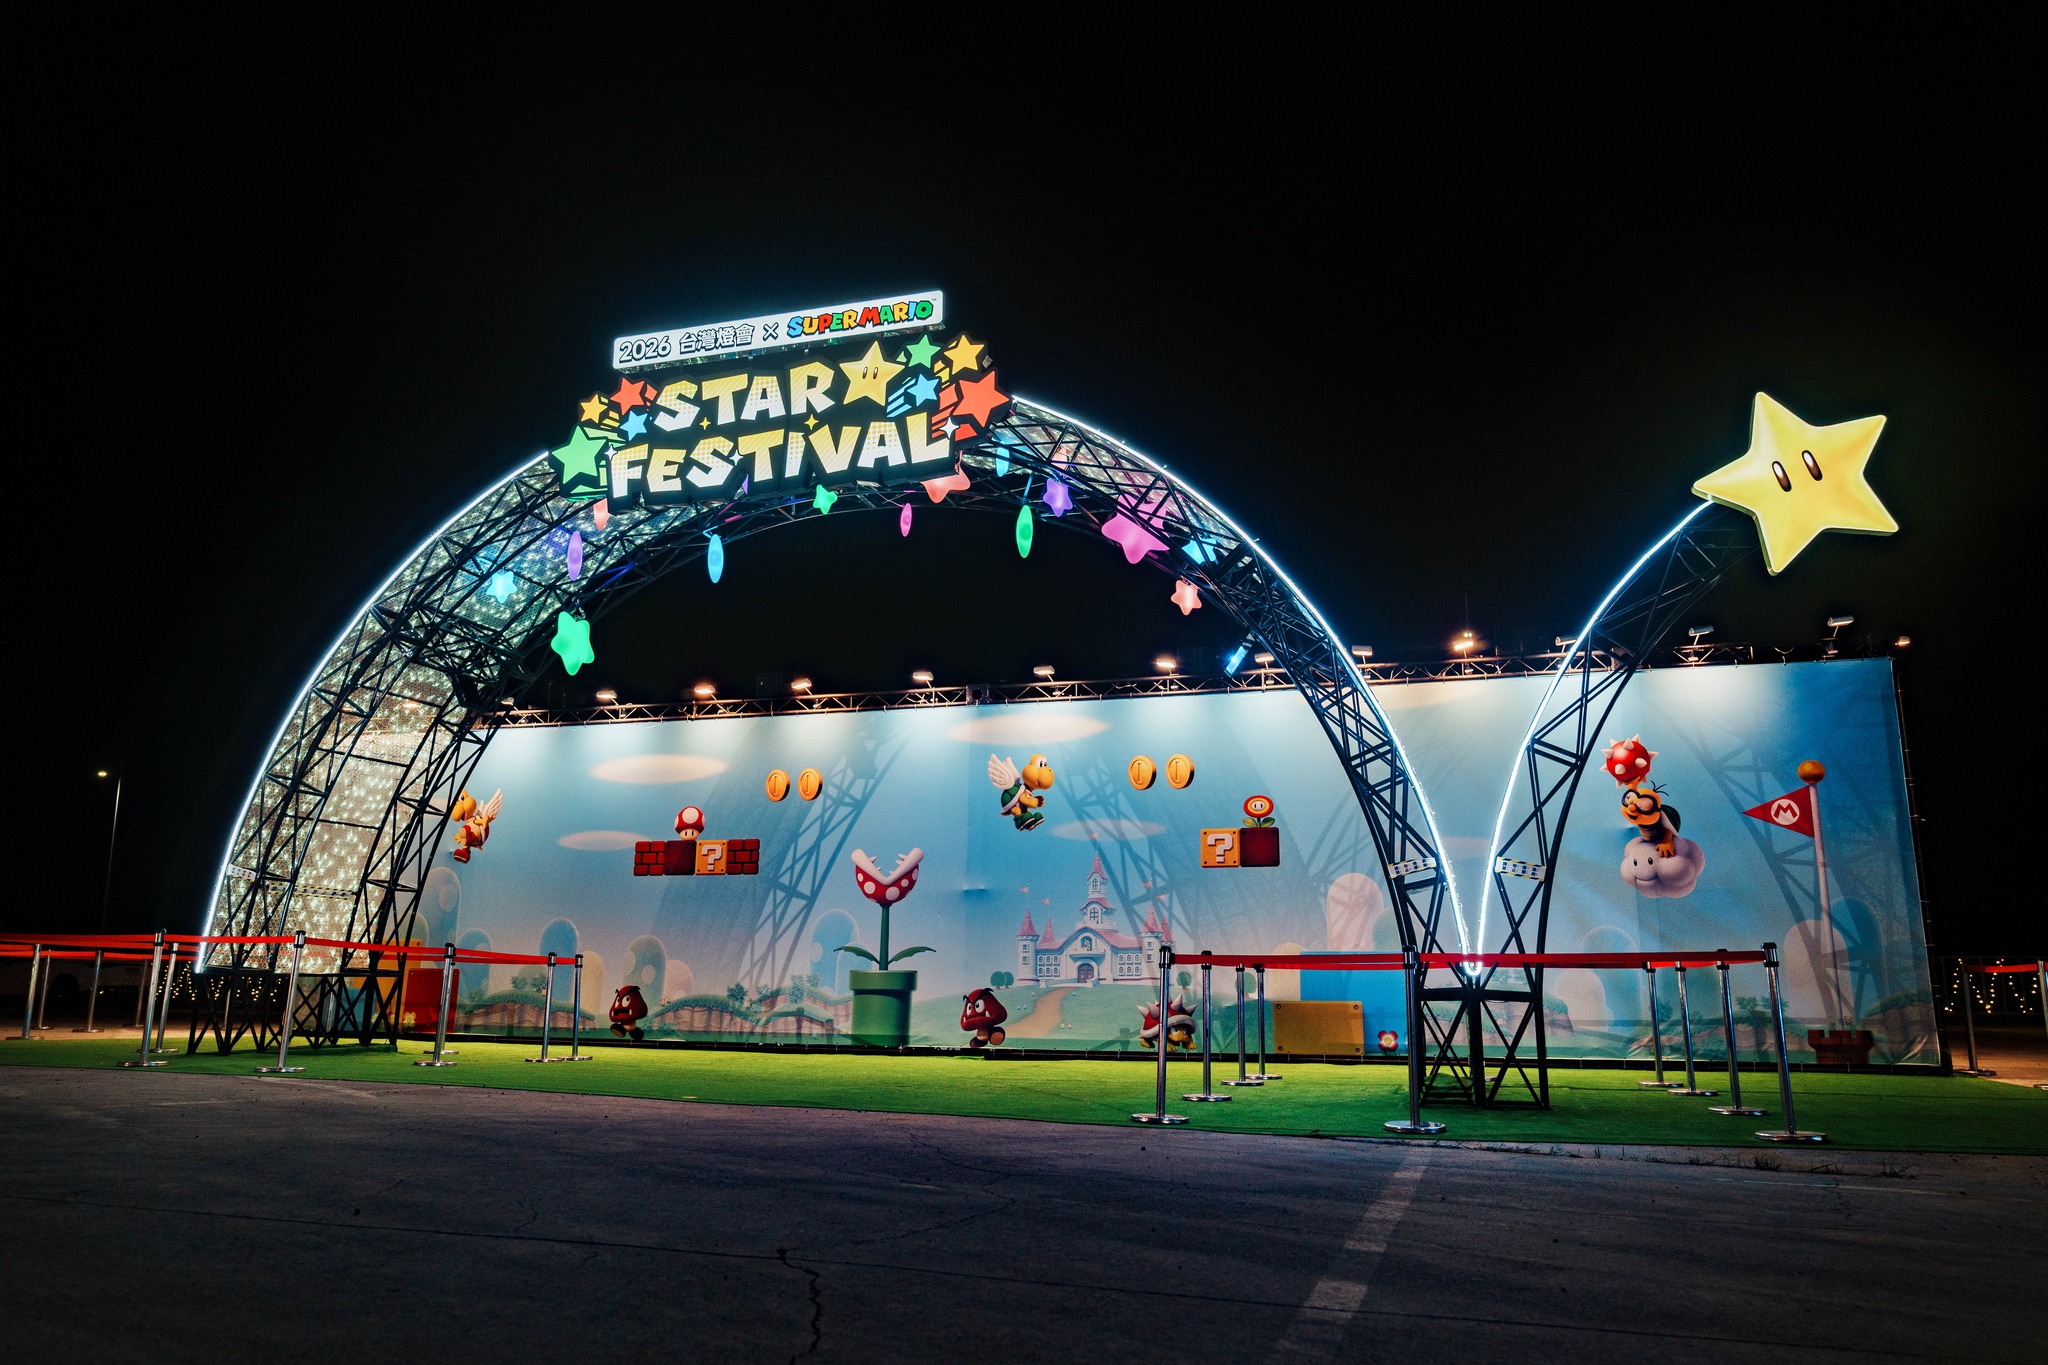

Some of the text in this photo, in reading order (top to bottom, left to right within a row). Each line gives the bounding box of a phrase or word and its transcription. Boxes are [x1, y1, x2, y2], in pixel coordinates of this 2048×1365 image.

[618, 335, 672, 364] 2026
[678, 323, 756, 355] 台灣燈會
[786, 309, 858, 338] SUPER
[857, 299, 935, 327] MARIO
[653, 361, 835, 432] STAR
[609, 412, 951, 499] FESTIVAL
[1773, 803, 1798, 819] M
